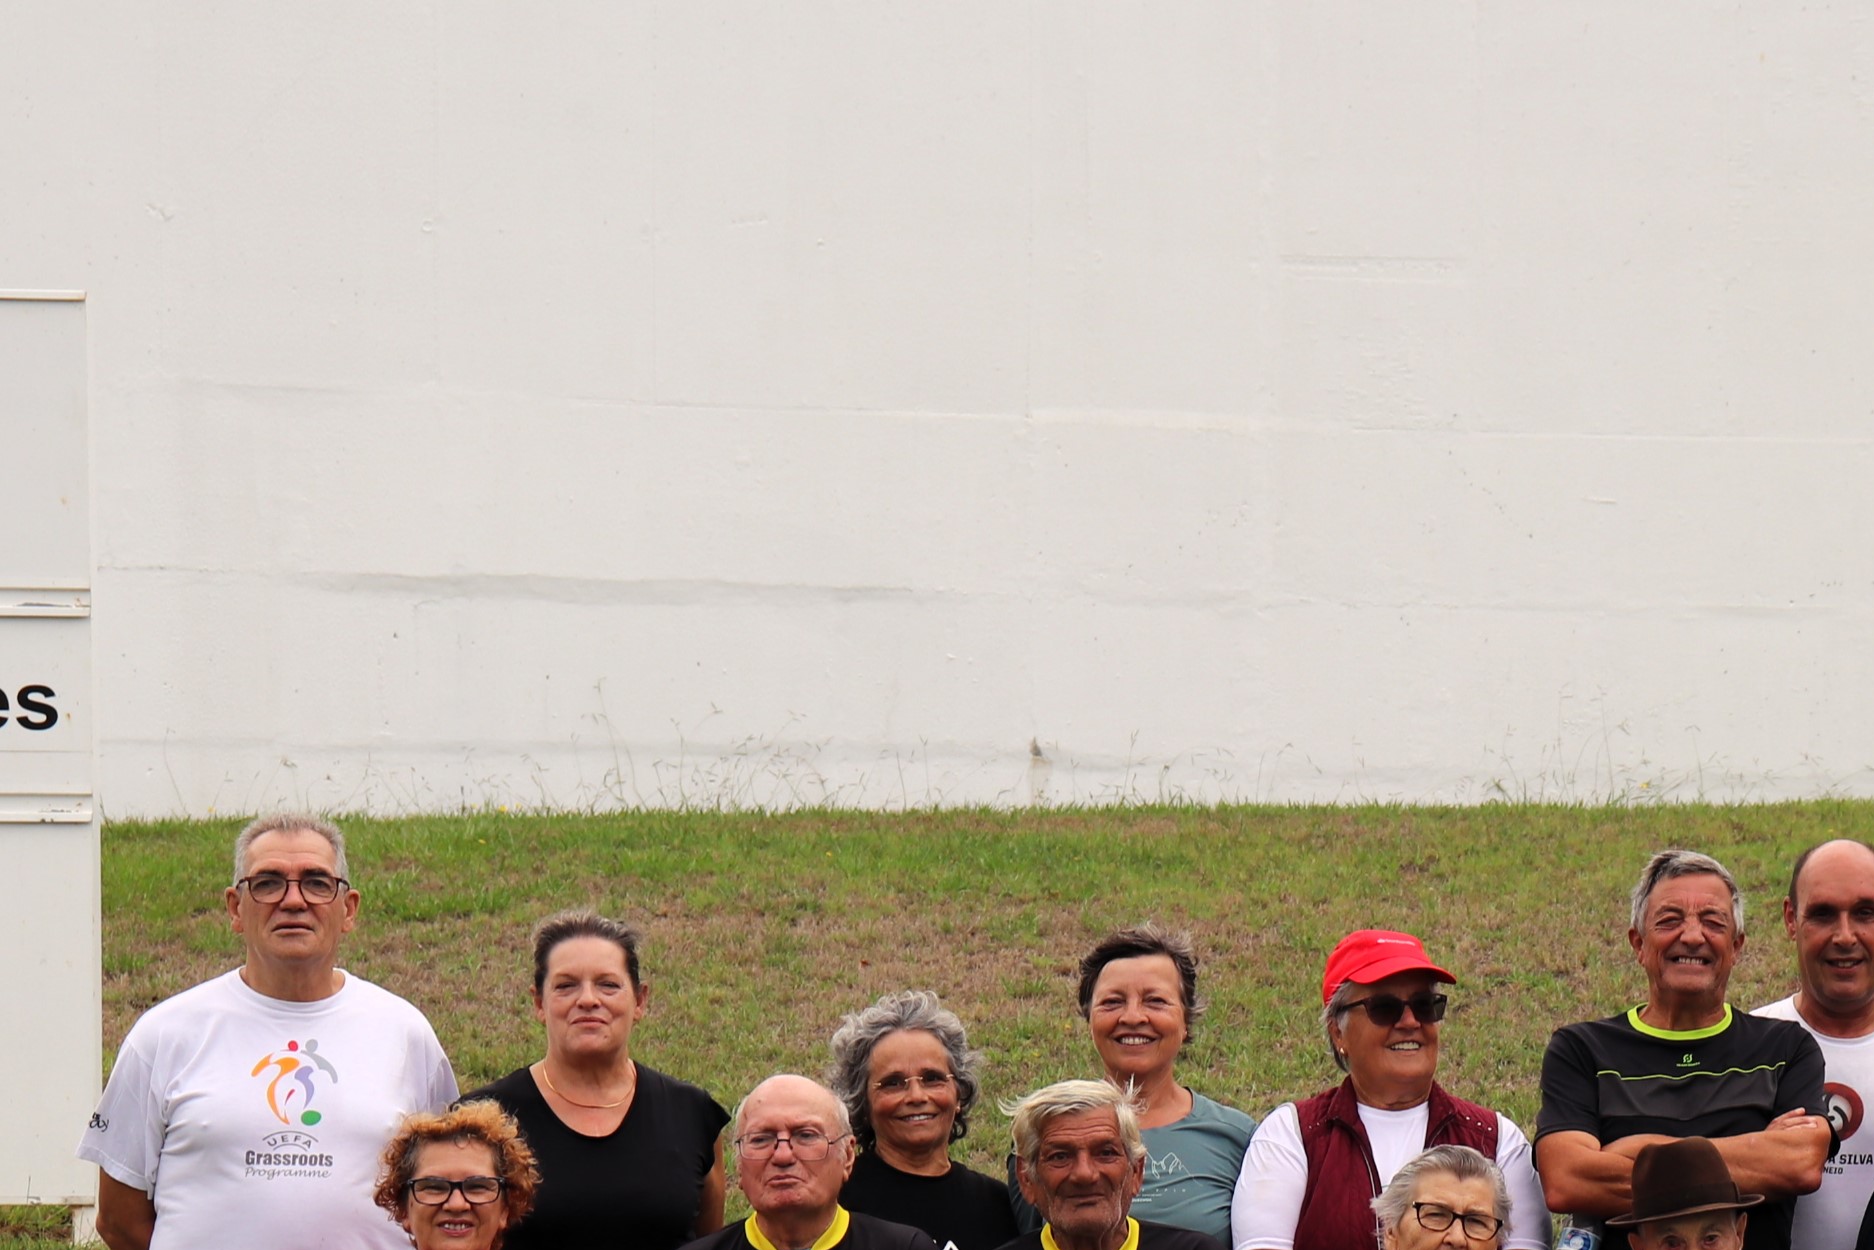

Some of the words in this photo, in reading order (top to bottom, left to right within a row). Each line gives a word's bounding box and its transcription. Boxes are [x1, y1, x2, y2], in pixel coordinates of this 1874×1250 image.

[0, 685, 58, 731] s
[267, 1133, 312, 1147] UEFA
[245, 1150, 333, 1166] Grassroots
[1839, 1154, 1873, 1165] SILVA
[245, 1167, 331, 1179] Programme
